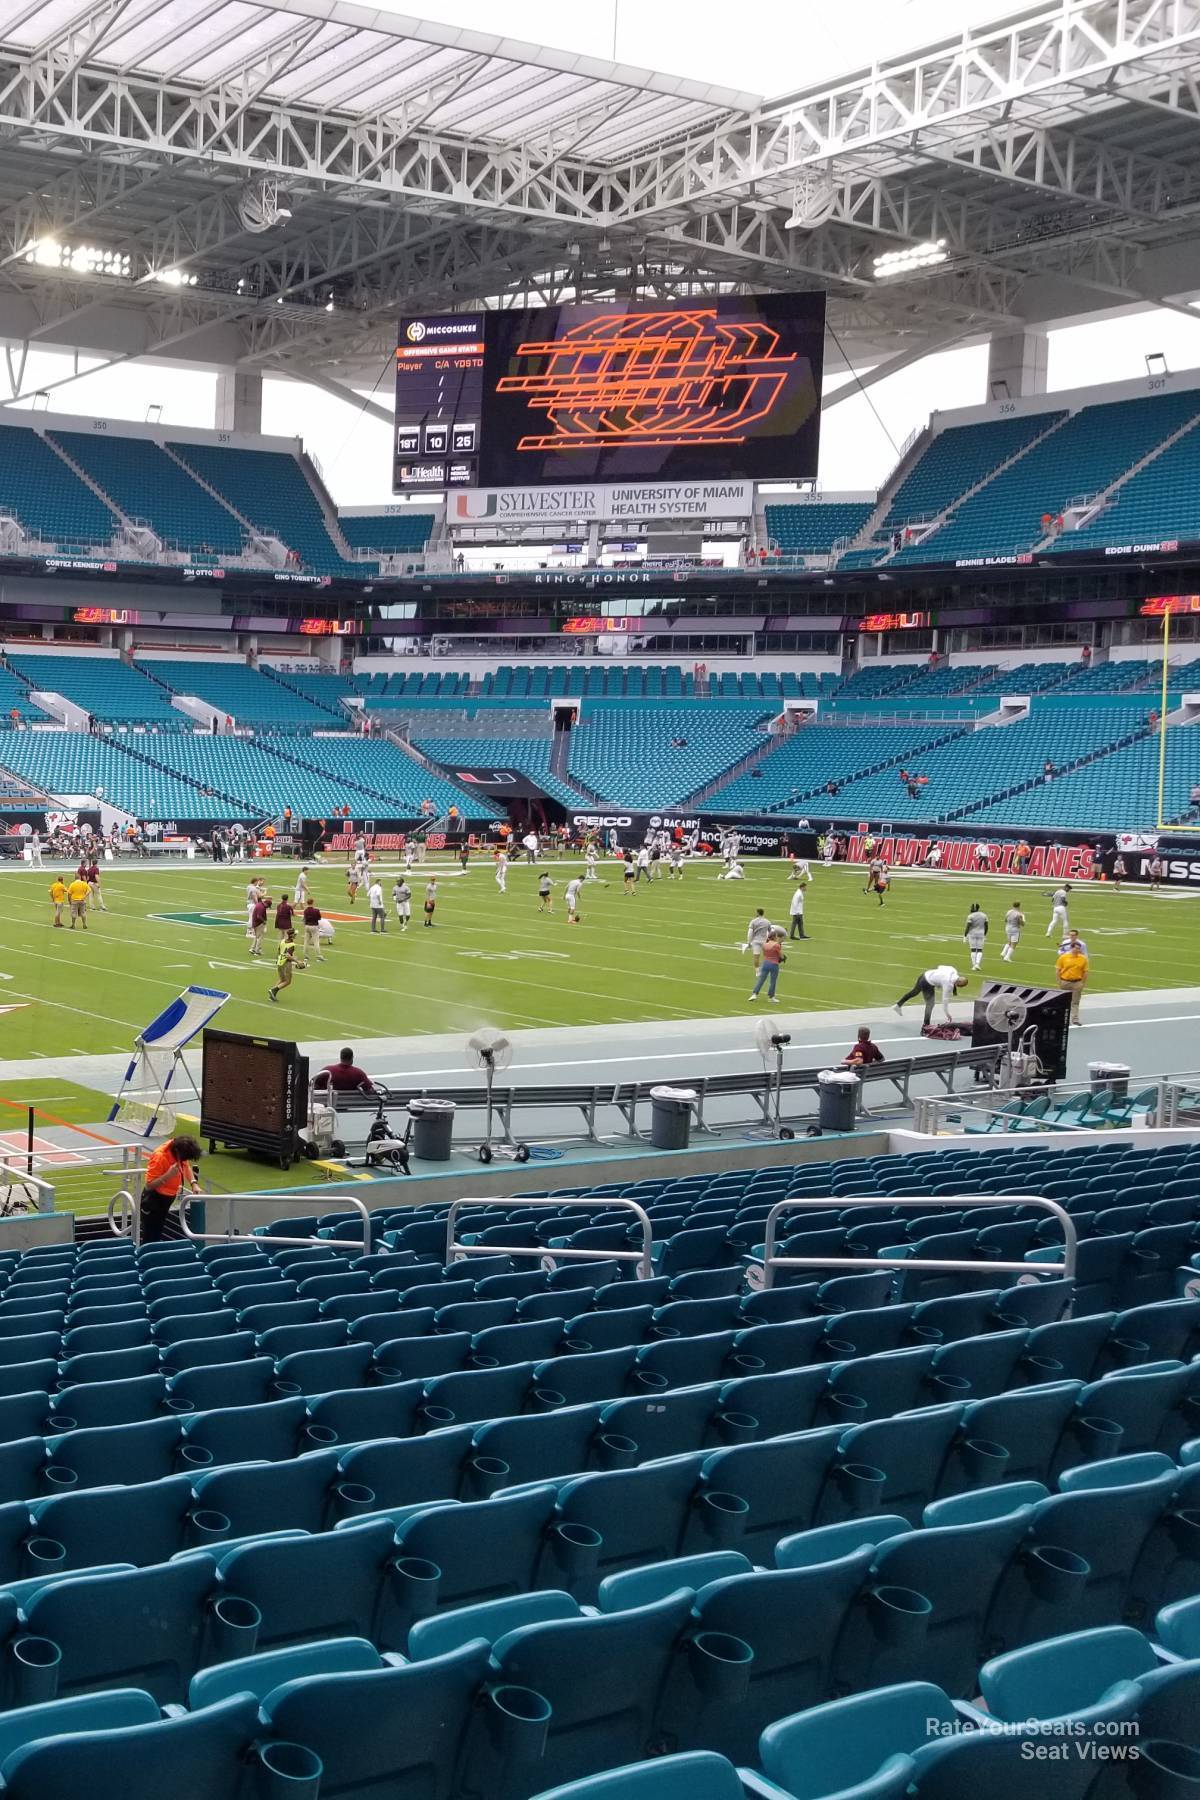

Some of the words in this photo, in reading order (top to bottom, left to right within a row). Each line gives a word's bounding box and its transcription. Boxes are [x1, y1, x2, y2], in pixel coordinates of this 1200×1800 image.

[426, 324, 477, 335] MICCOSUKEE
[403, 348, 437, 357] OFFENSIVE
[439, 346, 457, 354] GAME
[458, 345, 477, 353] STATS
[397, 362, 423, 372] Player
[471, 358, 483, 367] TD
[1148, 379, 1166, 391] 301
[999, 403, 1015, 414] 356
[93, 420, 107, 431] 350
[217, 433, 230, 443] 351
[400, 438, 417, 449] 1ST
[429, 437, 442, 449] 10
[456, 436, 471, 447] 25
[612, 487, 683, 502] UNIVERSITY
[684, 487, 701, 499] OF
[703, 486, 745, 499] MIAMI
[804, 492, 823, 502] 355
[499, 491, 596, 511] SYLVESTER
[385, 504, 401, 514] 352
[611, 502, 657, 515] HEALTH
[659, 501, 708, 514] SYSTEM
[1105, 544, 1132, 555] EDDIE
[1133, 543, 1160, 553] DUNN
[46, 559, 71, 568] CORTEZ
[73, 561, 103, 570] KENNEDY
[956, 558, 984, 567] BENNIE
[985, 556, 1016, 565] BLADES
[183, 568, 195, 576] JIM
[196, 569, 212, 577] OTTO
[536, 574, 577, 584] RING
[592, 572, 650, 584] HONOR
[573, 816, 632, 827] GEICO
[740, 833, 779, 846] Mortgage
